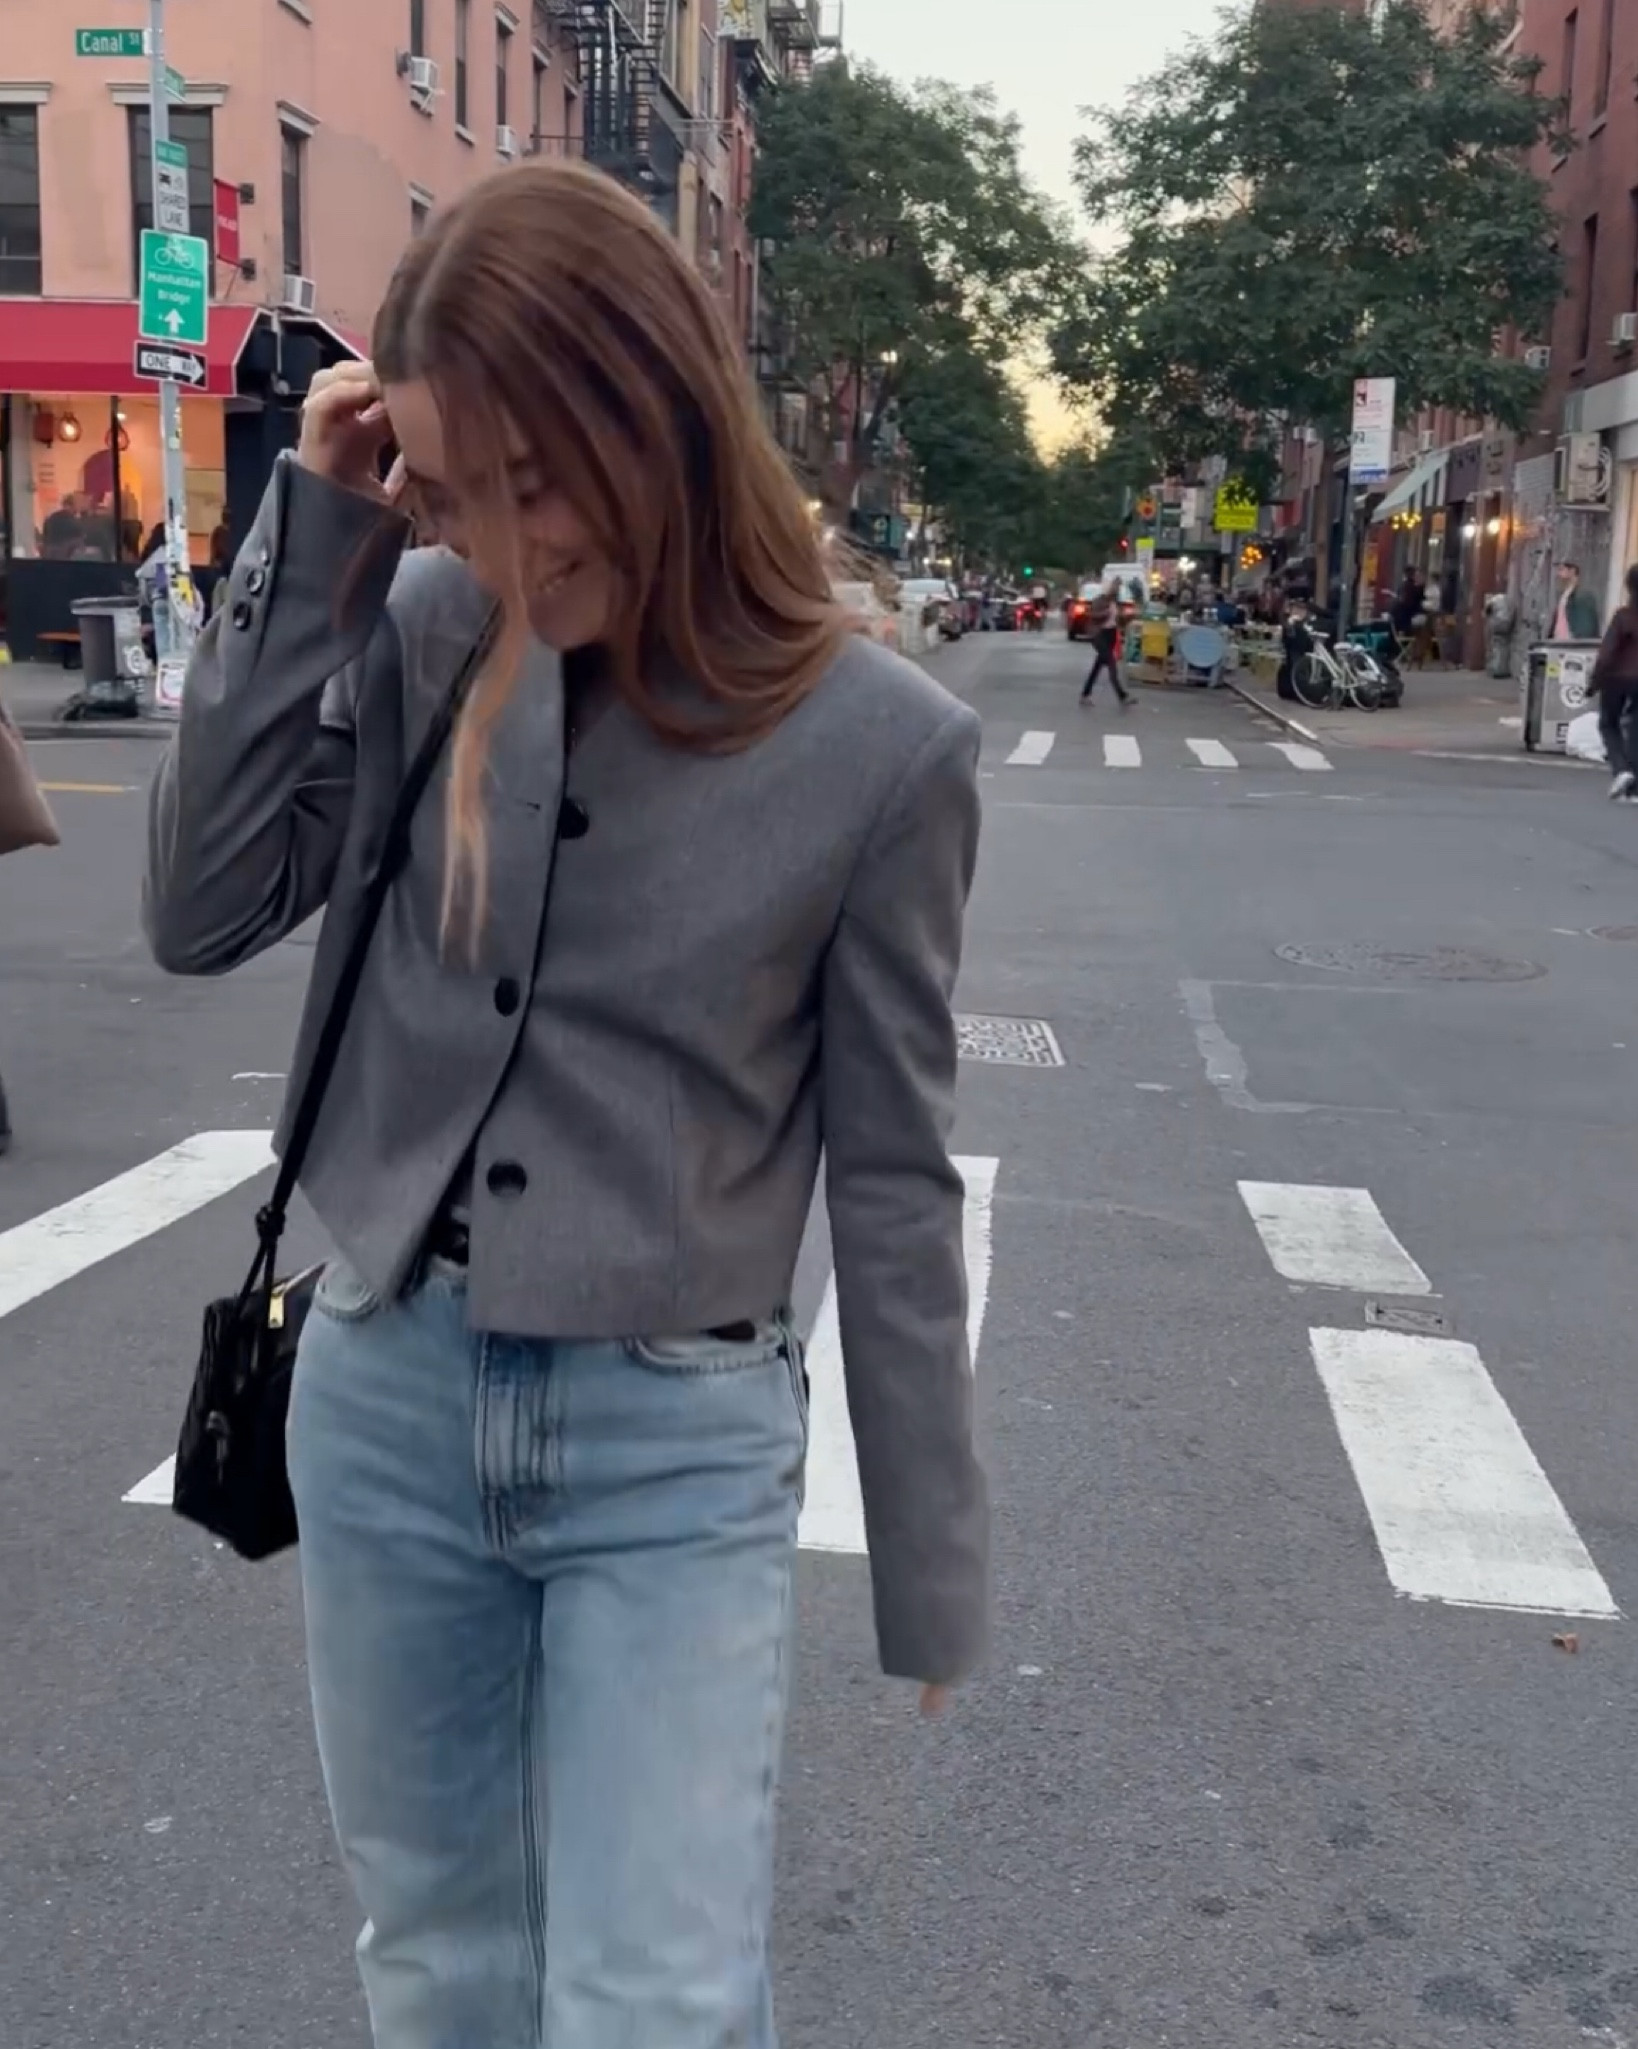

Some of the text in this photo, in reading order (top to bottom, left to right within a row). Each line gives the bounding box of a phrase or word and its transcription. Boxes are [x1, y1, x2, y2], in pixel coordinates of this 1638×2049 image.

[81, 31, 123, 53] Canal
[147, 270, 202, 289] Manhattan
[157, 289, 192, 305] Bridge
[145, 353, 170, 370] ONE
